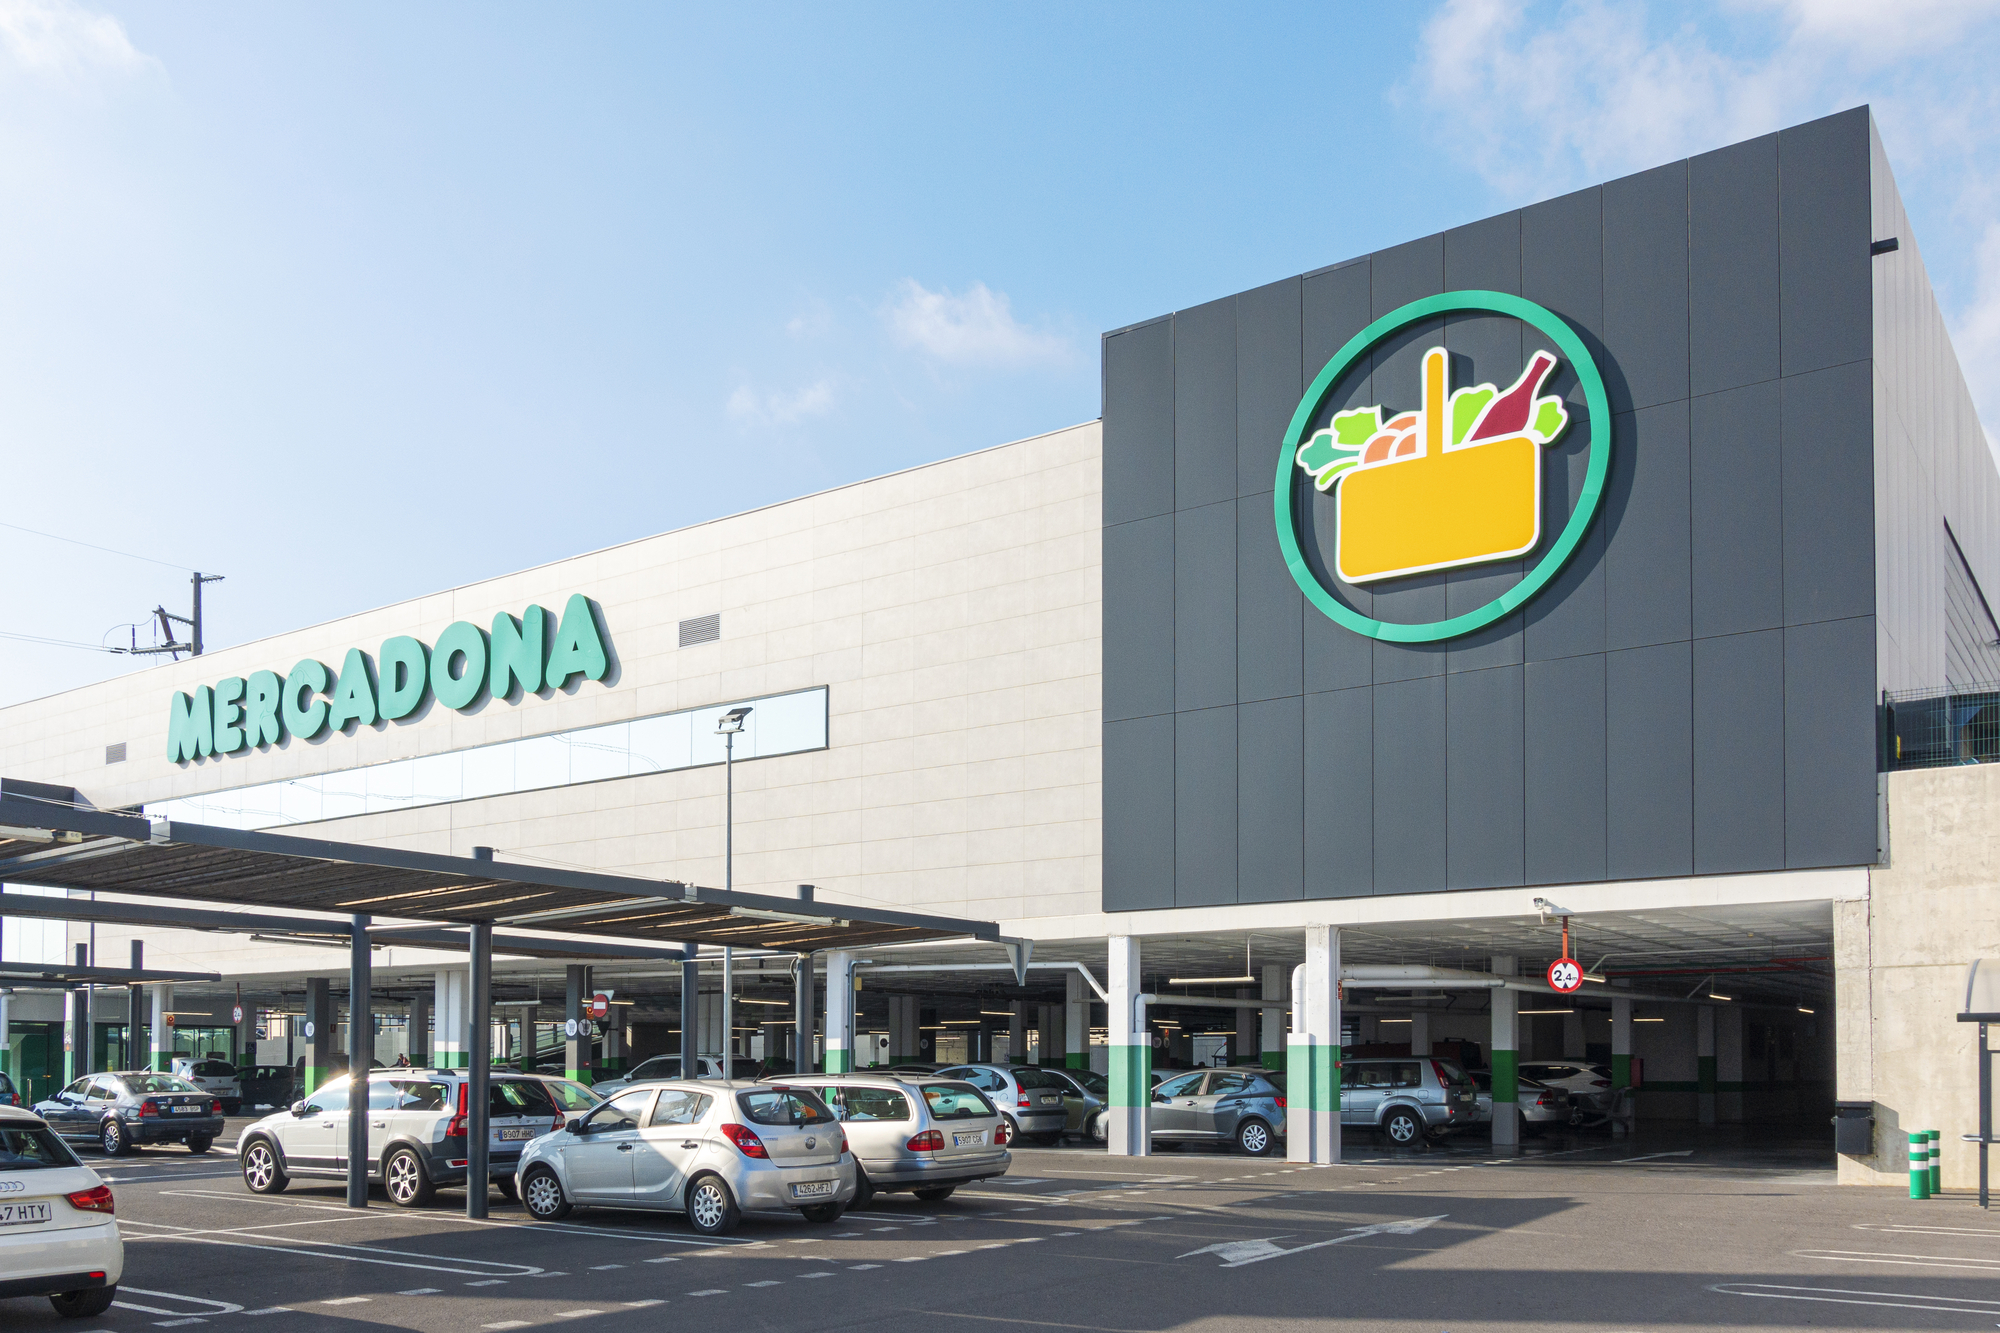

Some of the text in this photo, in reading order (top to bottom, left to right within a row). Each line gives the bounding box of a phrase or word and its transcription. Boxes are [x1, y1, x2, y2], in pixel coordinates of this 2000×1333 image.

[167, 592, 610, 764] MERCADONA
[503, 1130, 520, 1139] 8907
[958, 1135, 971, 1144] 5907
[800, 1184, 816, 1195] 4262
[818, 1183, 830, 1193] HFZ
[18, 1205, 45, 1220] HTY
